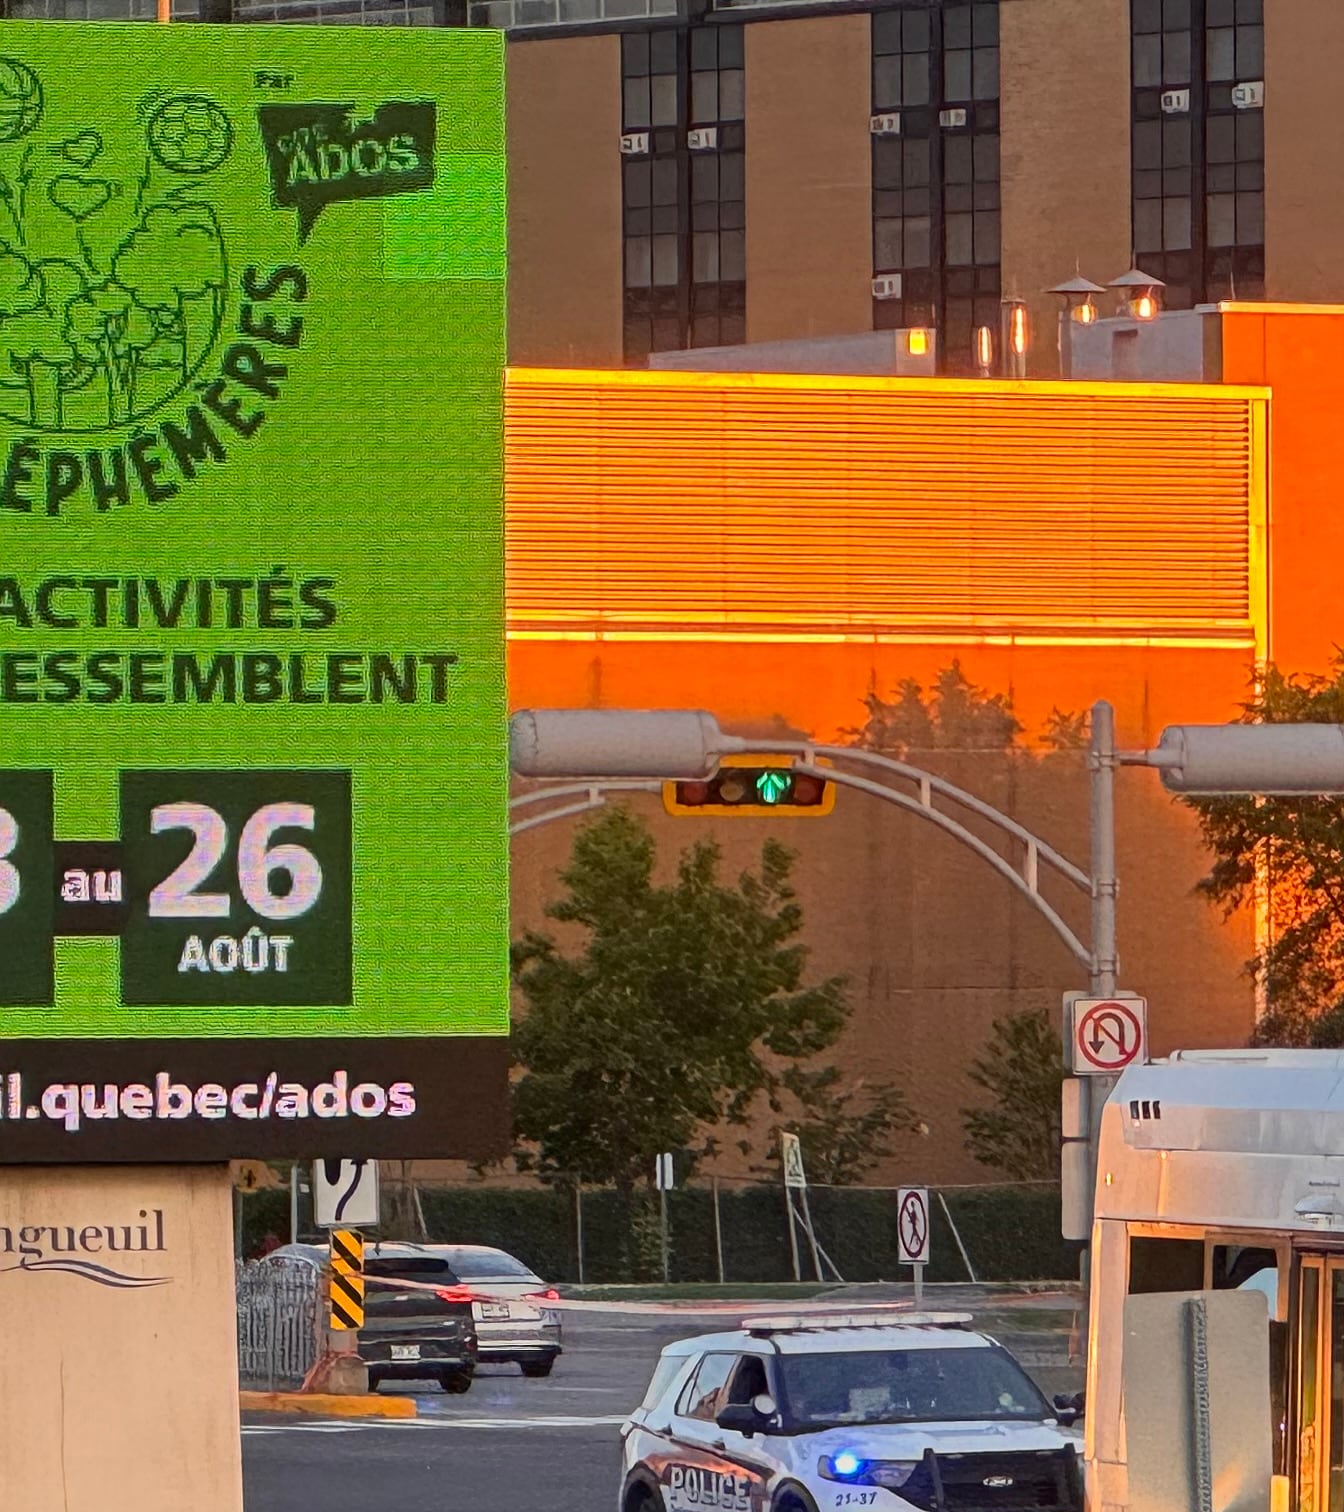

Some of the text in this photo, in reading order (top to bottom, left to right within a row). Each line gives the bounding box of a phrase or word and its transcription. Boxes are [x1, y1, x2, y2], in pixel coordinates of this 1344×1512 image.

[0, 565, 338, 629] ACTIVITÉS
[60, 867, 122, 903] au
[148, 801, 323, 921] 26
[178, 926, 294, 974] AOÛT
[0, 1071, 416, 1131] l.quebec/ados
[670, 1465, 749, 1511] POLICE
